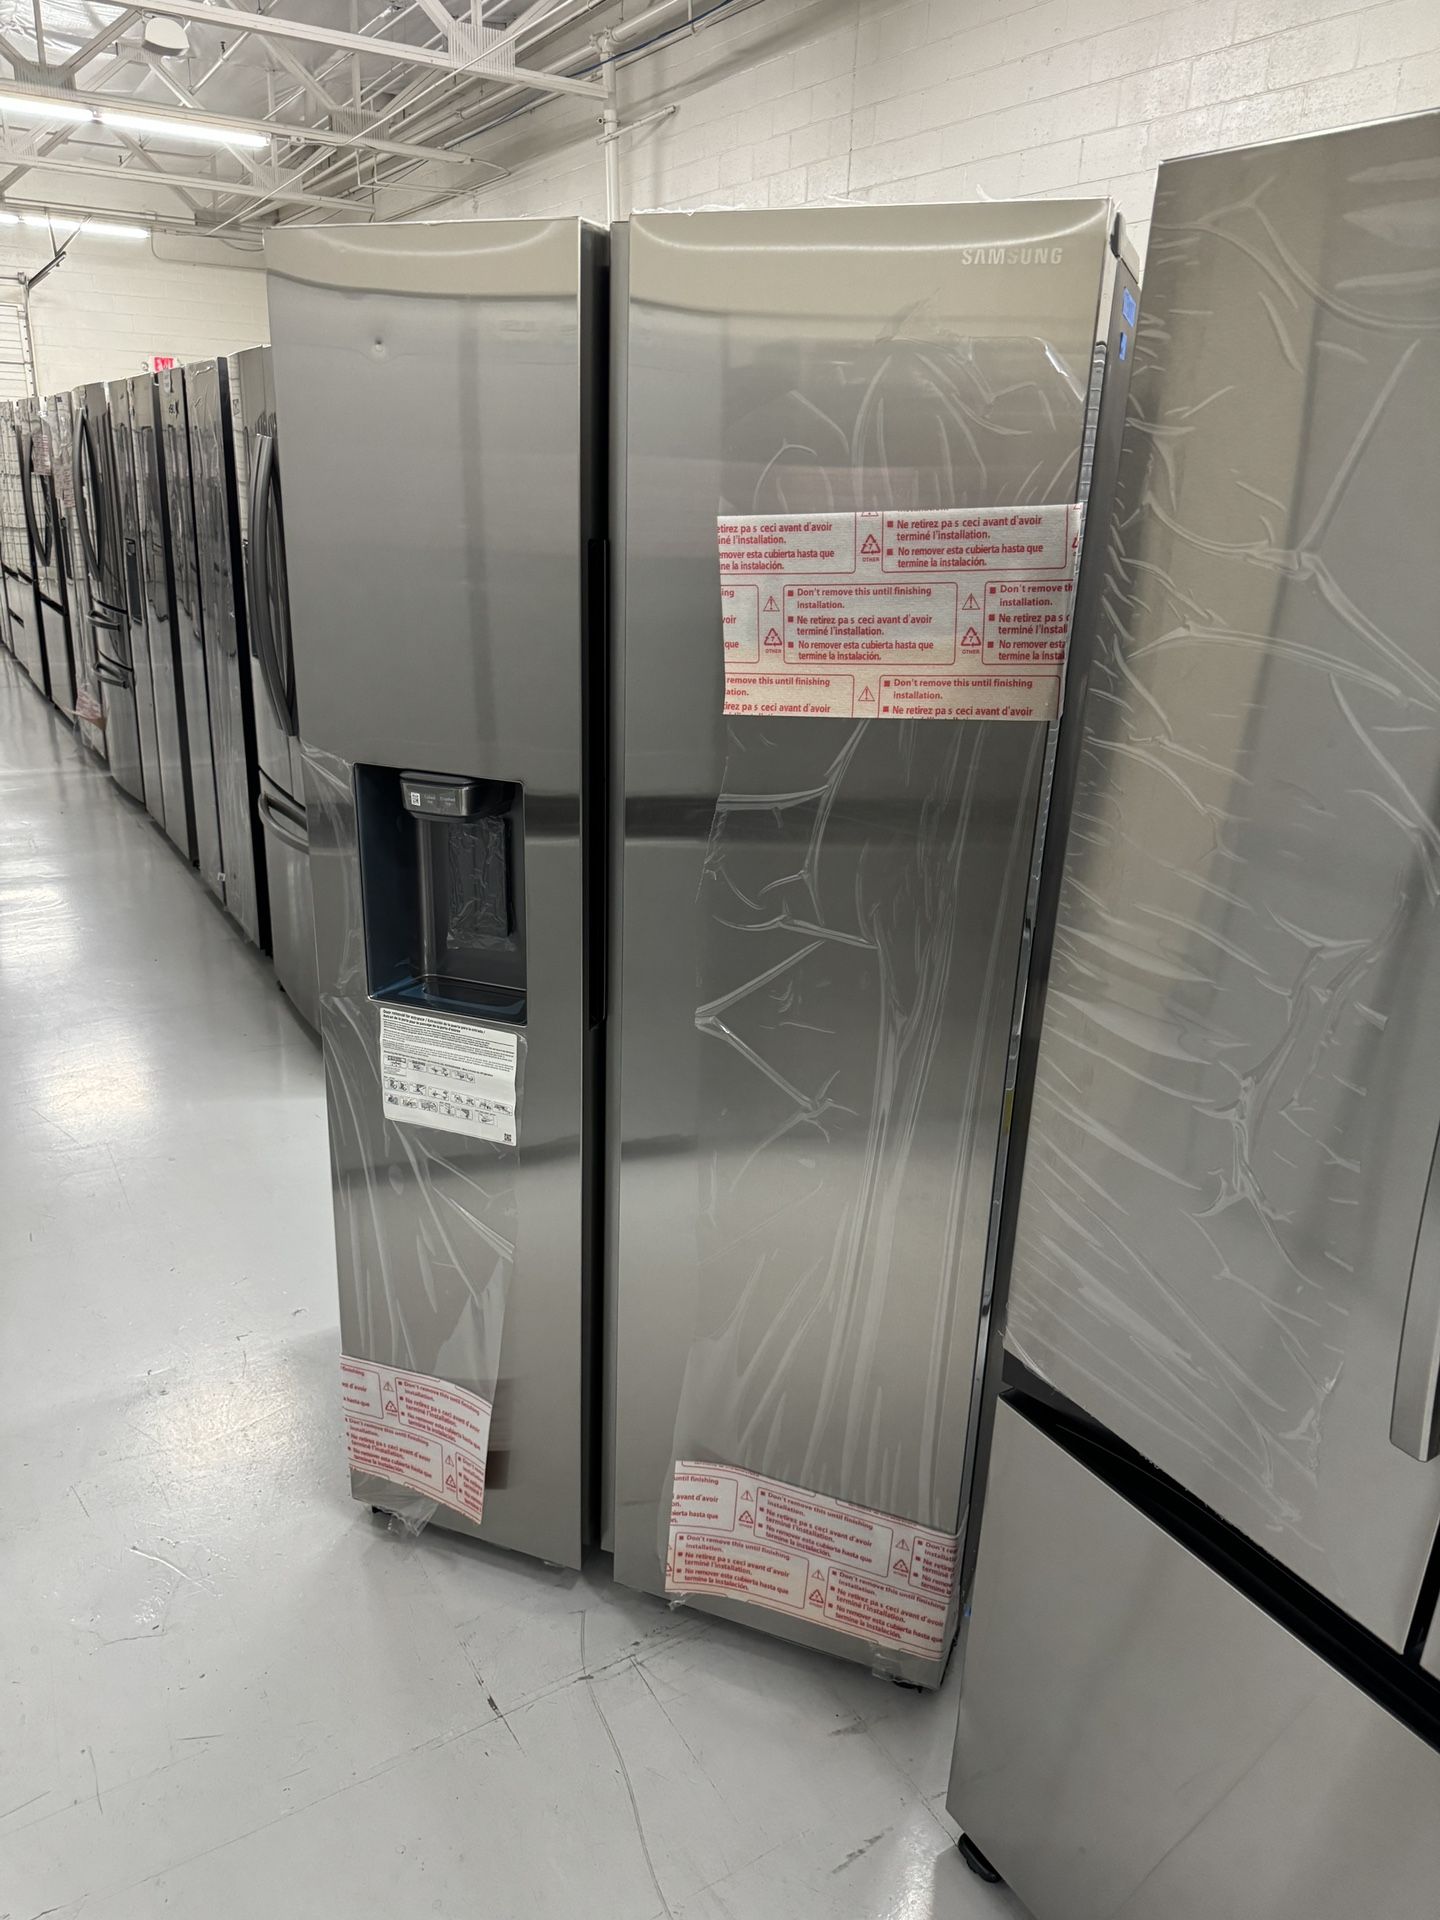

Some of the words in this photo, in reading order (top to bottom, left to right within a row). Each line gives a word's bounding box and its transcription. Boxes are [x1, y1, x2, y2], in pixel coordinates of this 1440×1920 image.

[962, 248, 1062, 264] SAMSUNG
[760, 523, 776, 533] ceci
[778, 524, 801, 533] avant
[804, 522, 832, 532] d'avoir
[897, 519, 909, 529] Ne
[911, 518, 938, 528] retirez
[962, 517, 980, 527] ceci
[982, 518, 1008, 527] avant
[1010, 516, 1042, 526] d'avoir
[733, 535, 786, 545] l'installation.
[896, 531, 930, 541] terminé
[932, 529, 990, 540] l'installation.
[746, 550, 762, 559] esta
[764, 549, 795, 558] cubierta
[797, 549, 817, 558] hasta
[819, 550, 835, 560] que
[898, 546, 910, 555] No
[911, 548, 944, 556] remover
[946, 546, 962, 555] esta
[965, 544, 999, 554] cubierta
[1001, 543, 1024, 553] hasta
[1027, 545, 1043, 555] que
[732, 561, 739, 570] la
[741, 560, 784, 570] instalación.
[897, 559, 928, 568] termine
[930, 558, 938, 567] la
[940, 557, 987, 567] instalación.
[797, 588, 820, 596] Don't
[873, 587, 892, 595] until
[894, 586, 931, 597] finishing
[1000, 584, 1026, 593] Don't
[797, 600, 845, 609] installation.
[1000, 597, 1052, 606] installation.
[797, 616, 808, 624] Ne
[809, 616, 835, 624] retirez
[858, 615, 875, 624] ceci
[877, 616, 901, 624] avant
[903, 614, 933, 623] d'avoir
[999, 614, 1011, 622] Ne
[1013, 613, 1041, 622] retirez
[797, 627, 828, 636] terminé
[830, 627, 884, 635] l'installation.
[998, 625, 1033, 634] terminé
[725, 641, 739, 650] que
[798, 641, 809, 649] No
[861, 641, 893, 649] cubierta
[895, 640, 916, 649] hasta
[918, 642, 933, 651] que
[999, 640, 1011, 648] No
[799, 652, 827, 660] termine
[828, 652, 837, 660] la
[838, 651, 881, 660] instalación.
[999, 652, 1030, 660] termine
[1033, 651, 1039, 659] la
[759, 676, 773, 684] this
[775, 677, 793, 685] until
[795, 678, 830, 687] finishing
[953, 679, 969, 687] this
[971, 679, 992, 687] until
[994, 679, 1033, 689] finishing
[894, 691, 943, 699] installation.
[761, 703, 777, 711] ceci
[779, 704, 801, 712] avant
[803, 704, 831, 712] d'avoir
[893, 706, 904, 714] Ne
[906, 706, 933, 715] retirez
[955, 706, 972, 715] ceci
[976, 708, 999, 716] avant
[1002, 707, 1033, 716] d'avoir
